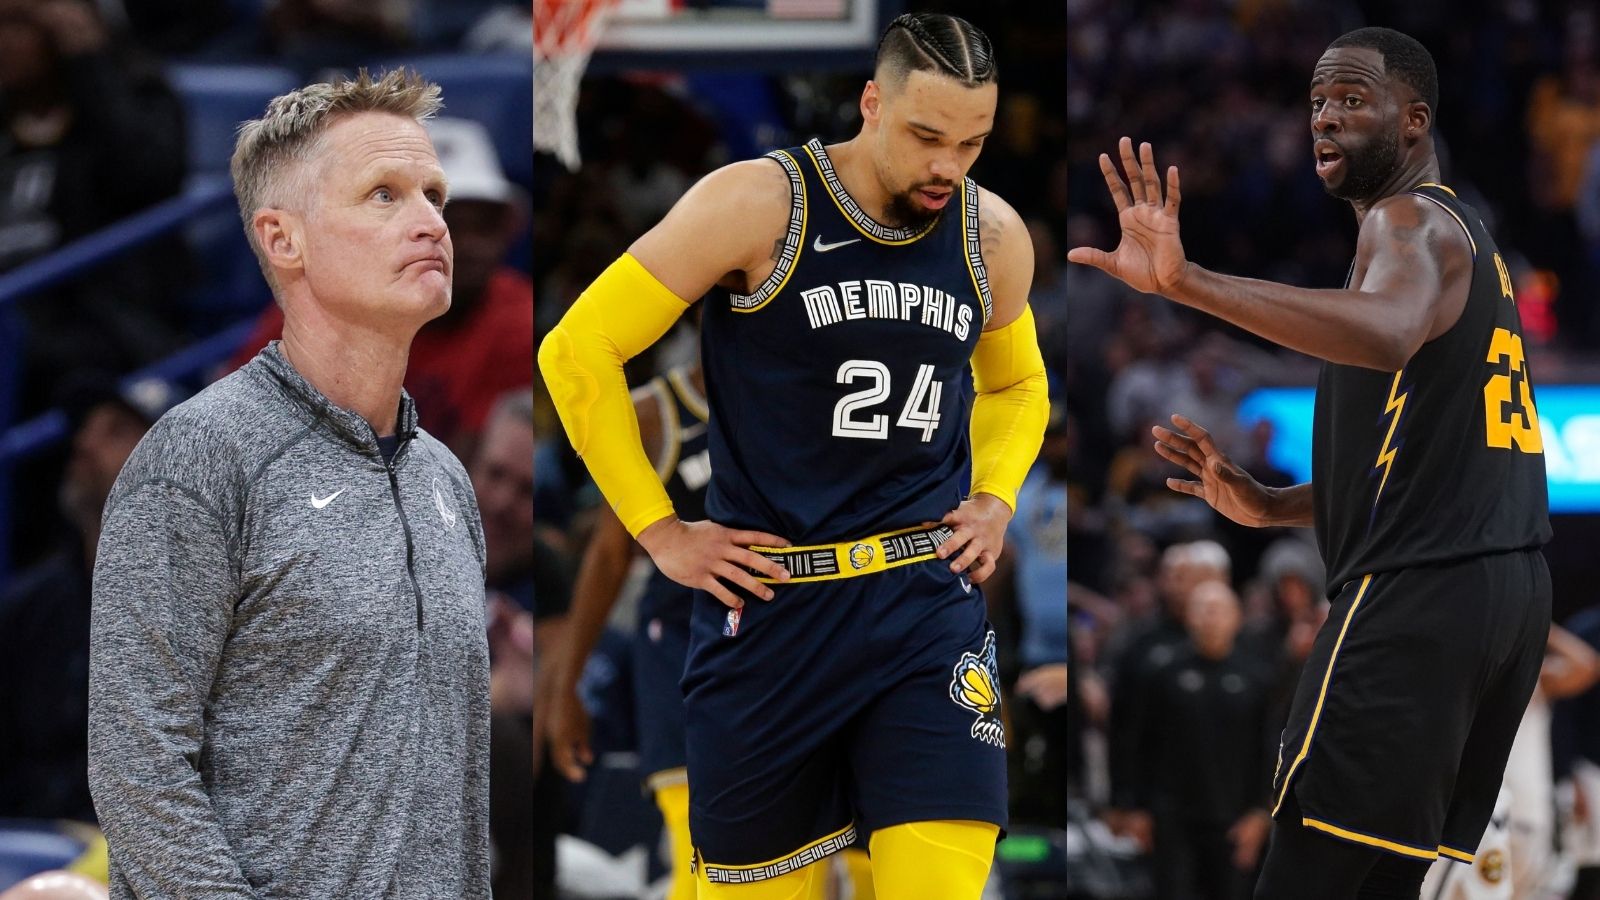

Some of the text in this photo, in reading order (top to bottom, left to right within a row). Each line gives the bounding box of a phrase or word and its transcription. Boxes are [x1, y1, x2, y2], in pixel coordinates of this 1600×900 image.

[800, 279, 973, 342] MEMPHIS
[832, 359, 943, 443] 24
[1484, 327, 1544, 454] 23
